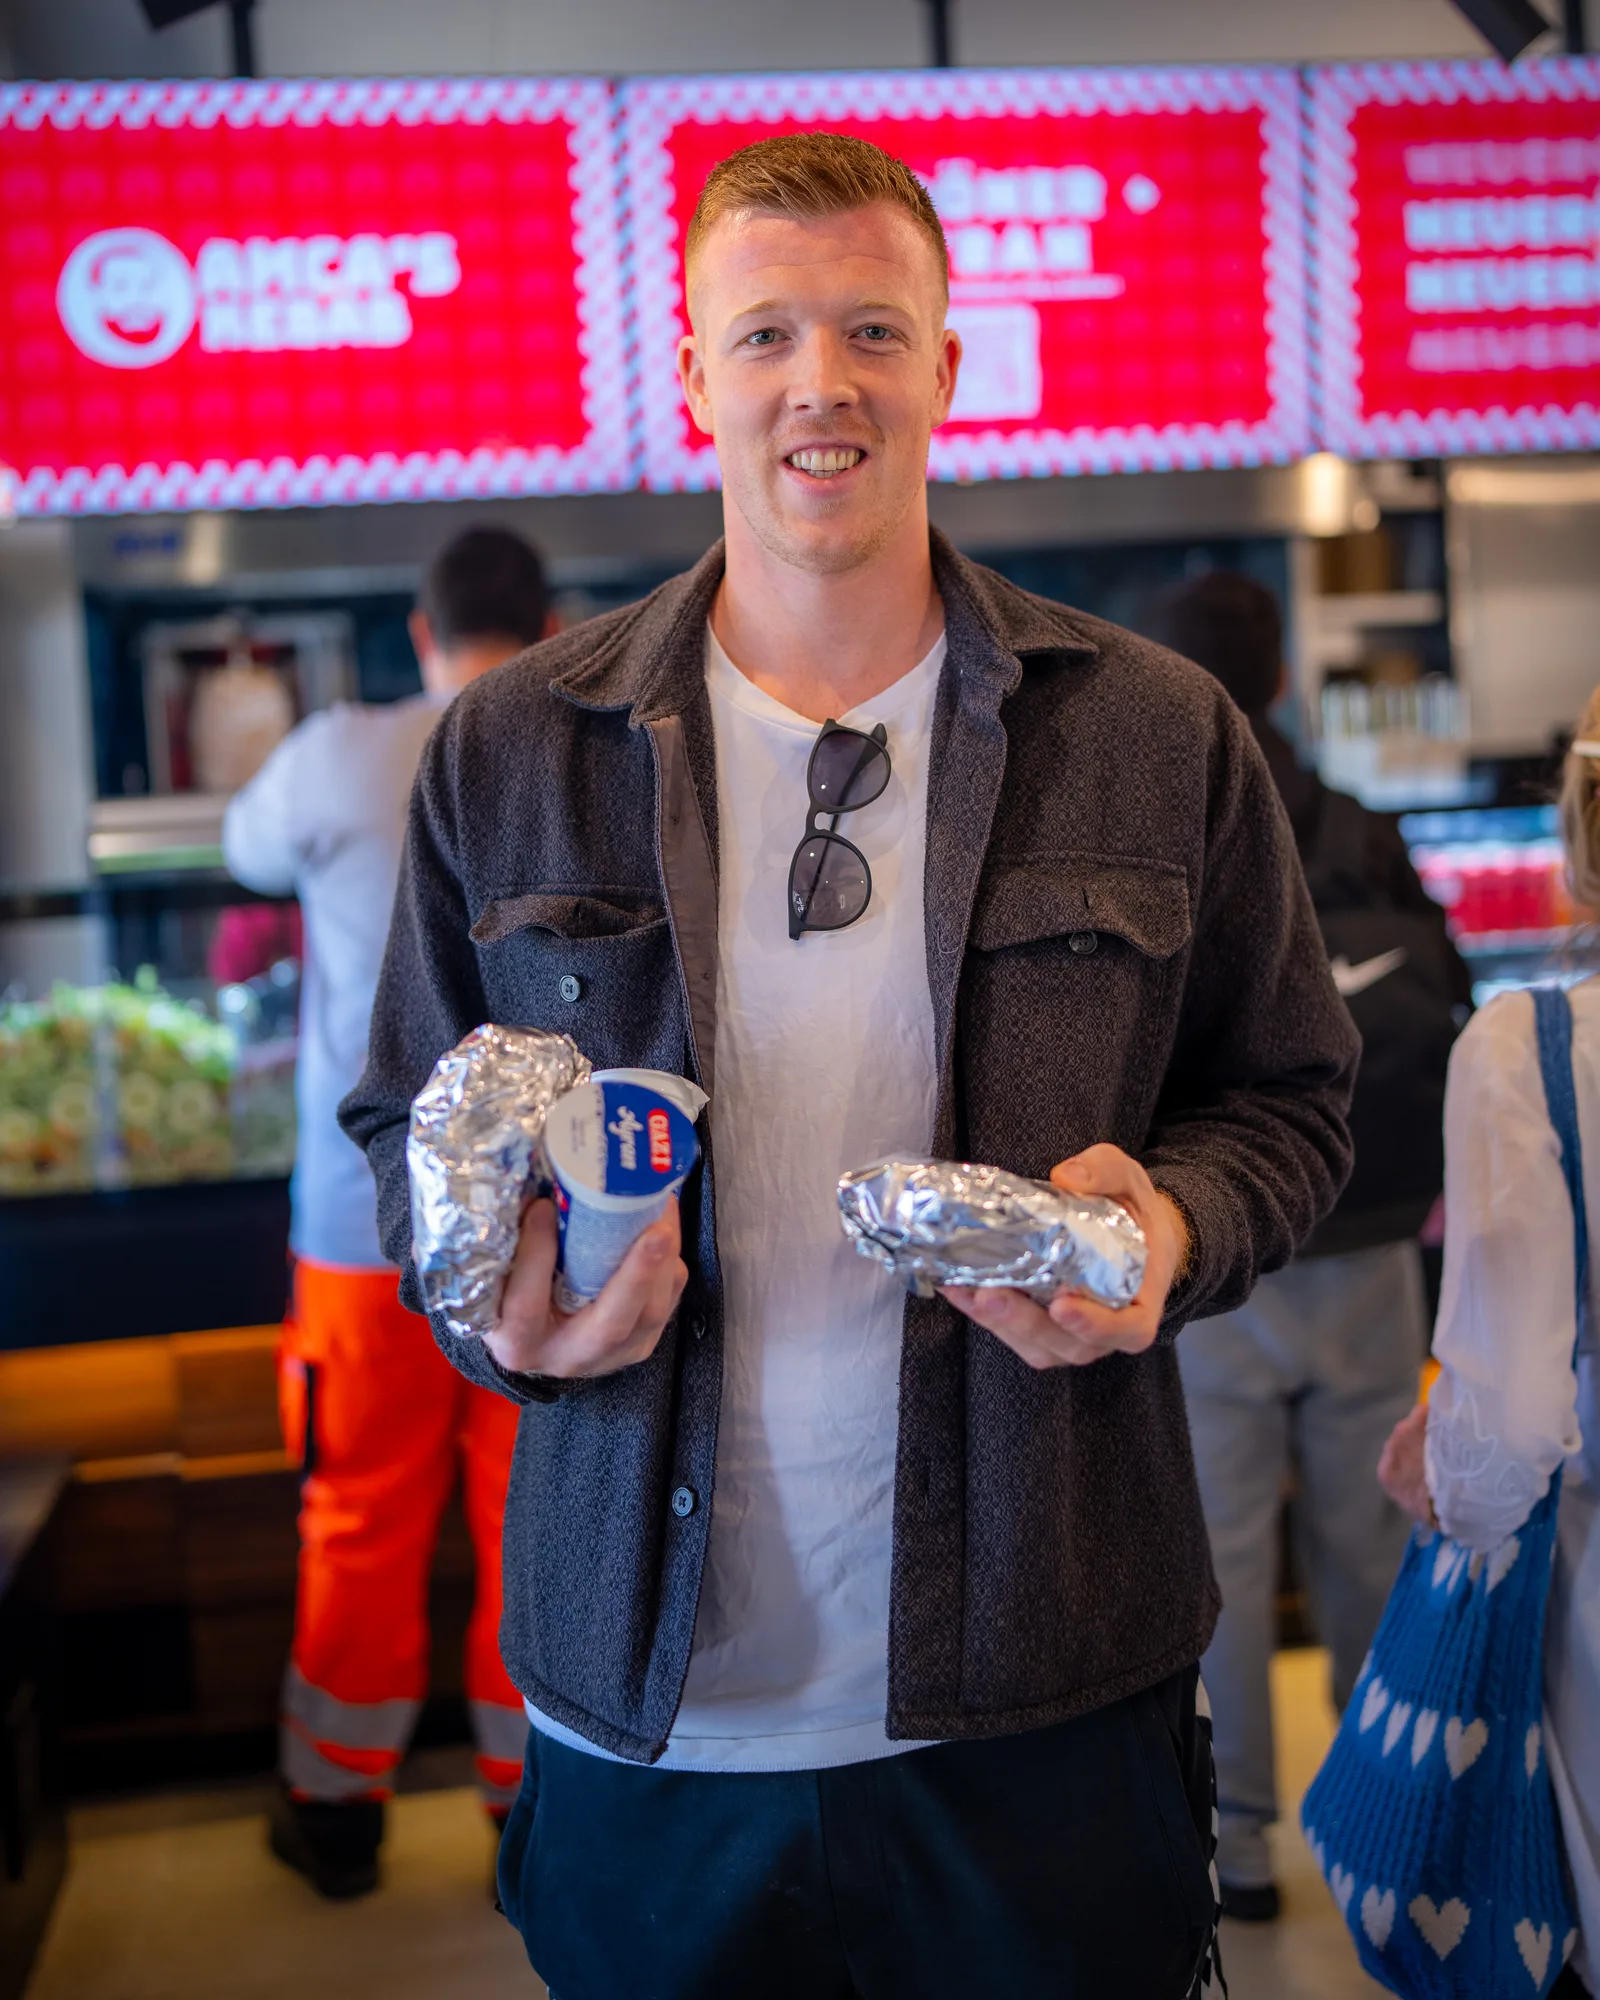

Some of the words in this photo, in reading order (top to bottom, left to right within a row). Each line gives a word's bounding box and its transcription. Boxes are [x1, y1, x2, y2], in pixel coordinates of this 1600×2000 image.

[914, 158, 1107, 221] ÖNER
[198, 232, 458, 296] AMCA'S
[608, 1106, 644, 1170] Ayran
[648, 1114, 671, 1165] GAZI
